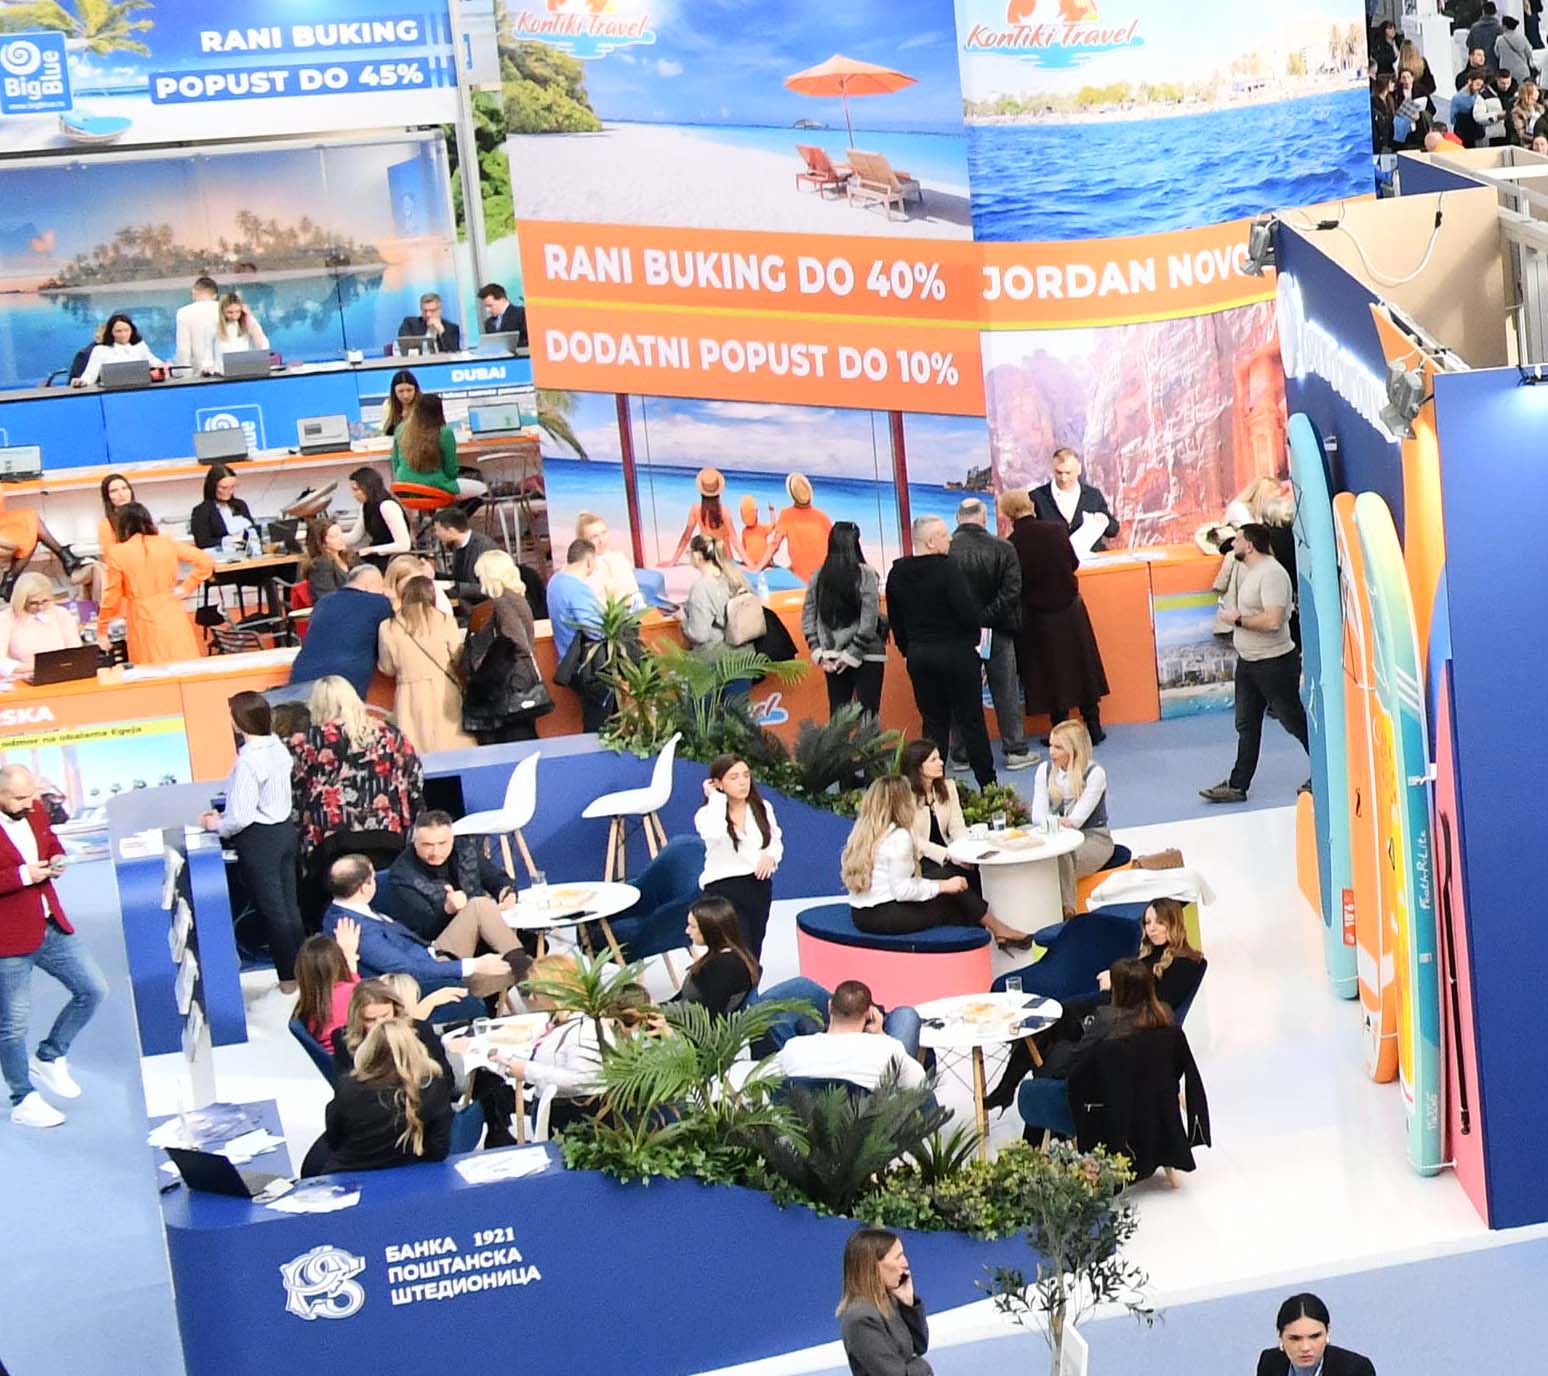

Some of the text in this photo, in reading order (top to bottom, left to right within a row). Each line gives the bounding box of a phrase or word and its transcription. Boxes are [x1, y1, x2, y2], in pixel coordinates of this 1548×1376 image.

[199, 19, 419, 53] RANI BUKING
[1060, 18, 1137, 43] Travel
[4, 50, 64, 101] Big Blue
[156, 62, 425, 100] POPUST DO 45%
[543, 242, 947, 301] RANI BUKING DO 40%
[982, 256, 1157, 302] JORDAN
[450, 366, 507, 384] DUBAI
[545, 329, 960, 385] DODATNI POPUST DO 10%
[385, 1226, 515, 1264] БАНКА 1921
[387, 1246, 523, 1285] ПОШТАНСКА
[390, 1264, 542, 1306] ШТЕДИОНИЦА
